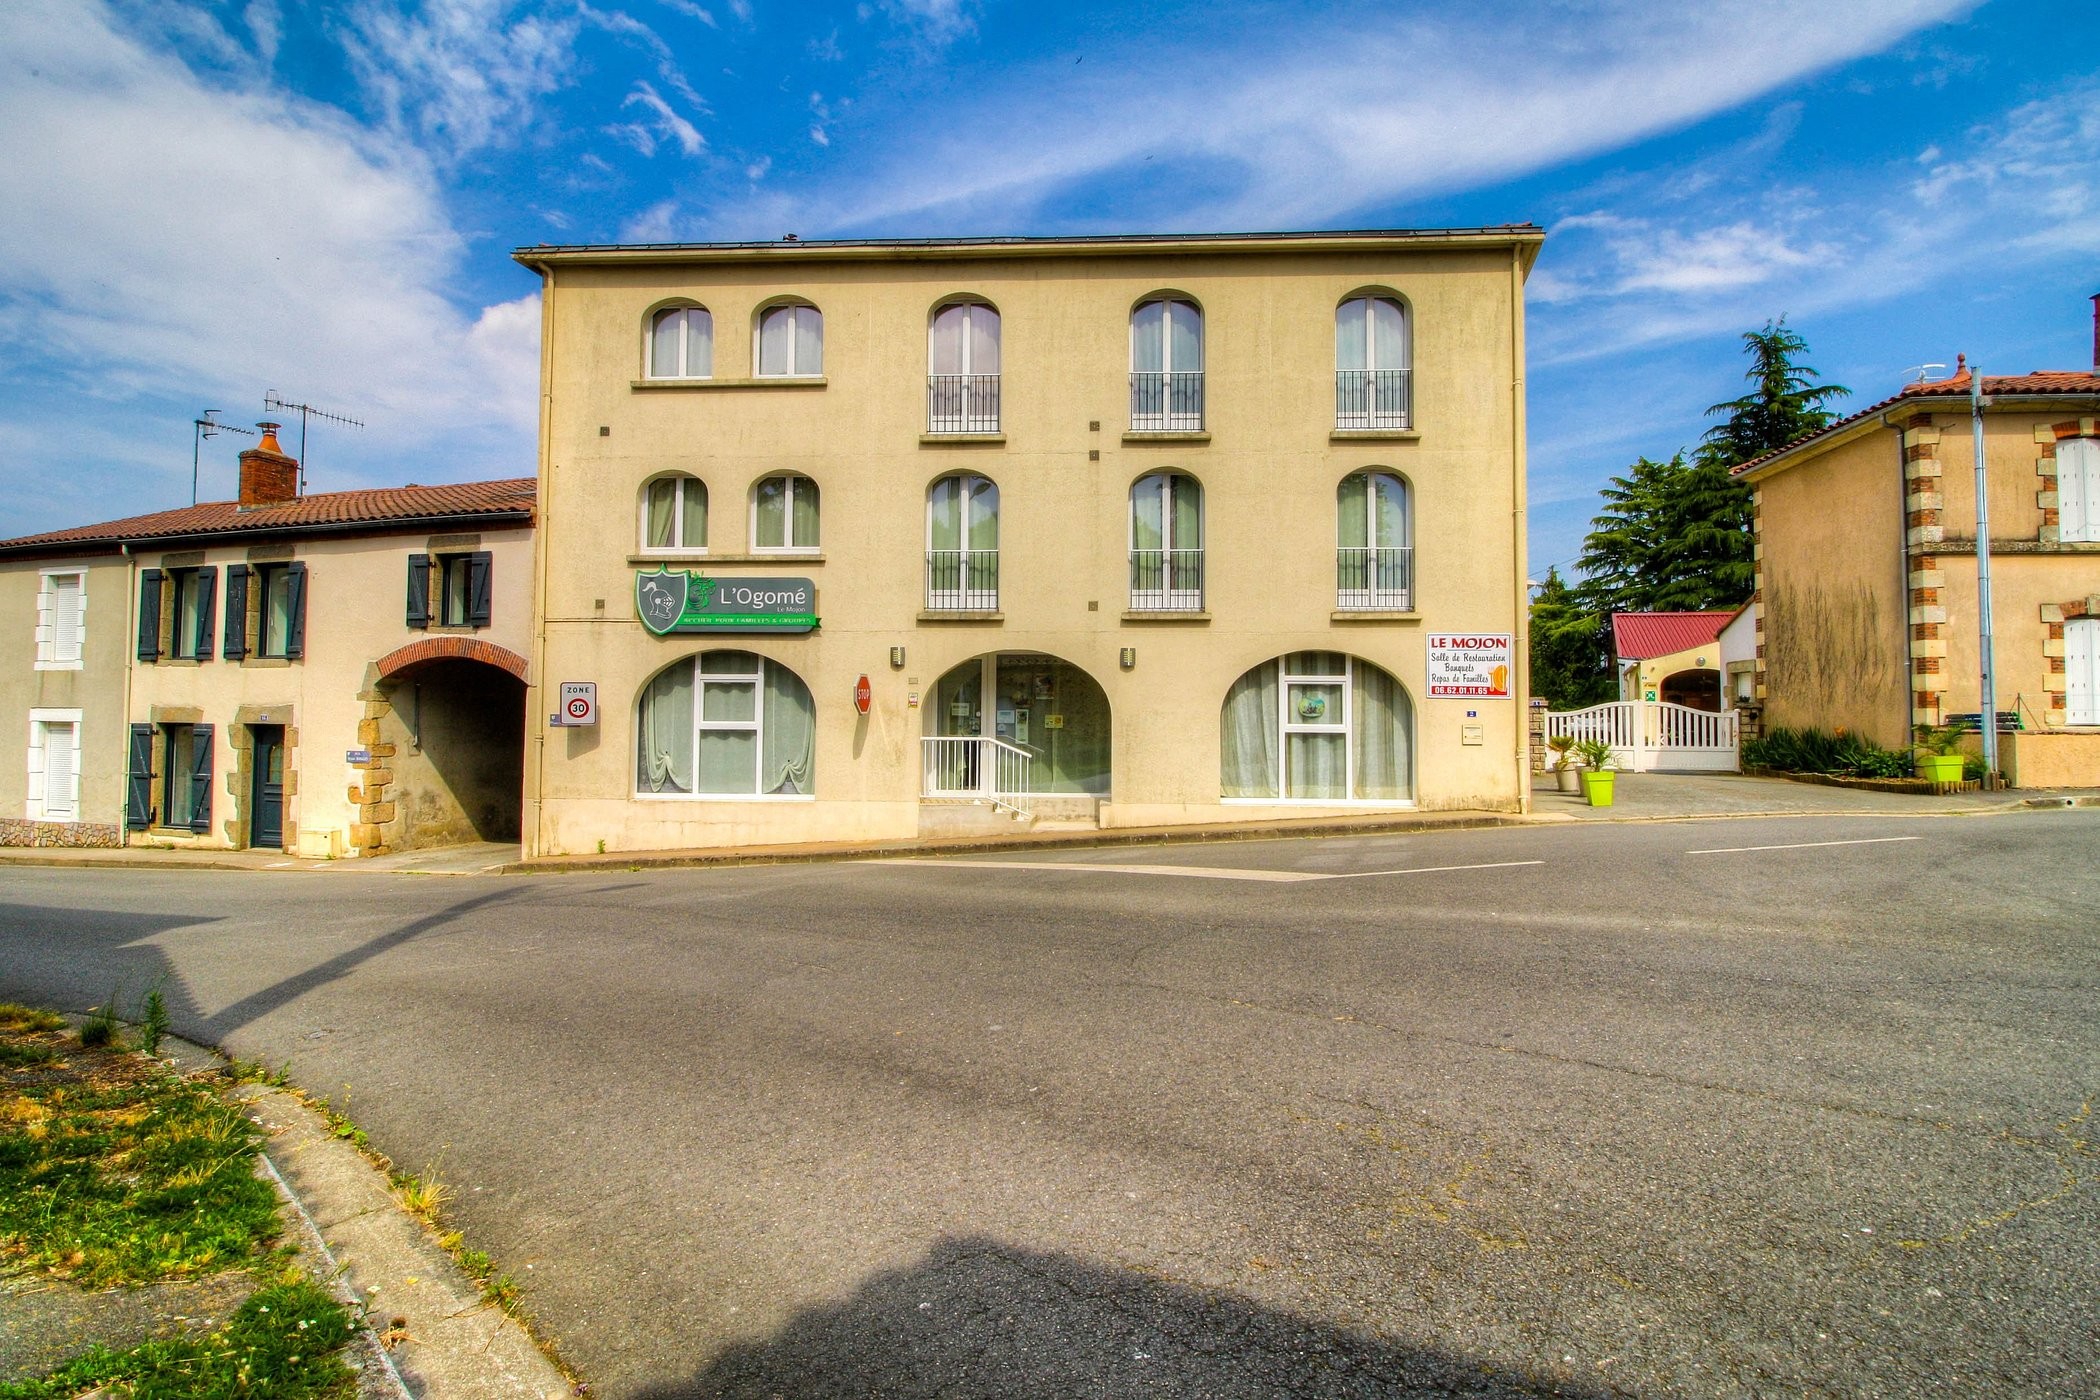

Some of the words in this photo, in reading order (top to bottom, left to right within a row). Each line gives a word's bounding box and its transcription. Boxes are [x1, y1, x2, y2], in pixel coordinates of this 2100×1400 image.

[720, 587, 806, 609] L'Ogomé
[1431, 638, 1446, 648] LE
[1451, 637, 1508, 650] MOJON
[1431, 652, 1449, 662] Salle
[1452, 652, 1460, 662] de
[1463, 652, 1506, 662] Restauration
[1445, 662, 1474, 674] Banquets
[1431, 673, 1450, 684] Repas
[1452, 673, 1460, 683] de
[1462, 673, 1489, 683] Familles
[858, 688, 869, 700] STOP
[1435, 686, 1488, 694] 06.62.01.11.65
[572, 704, 584, 712] 30
